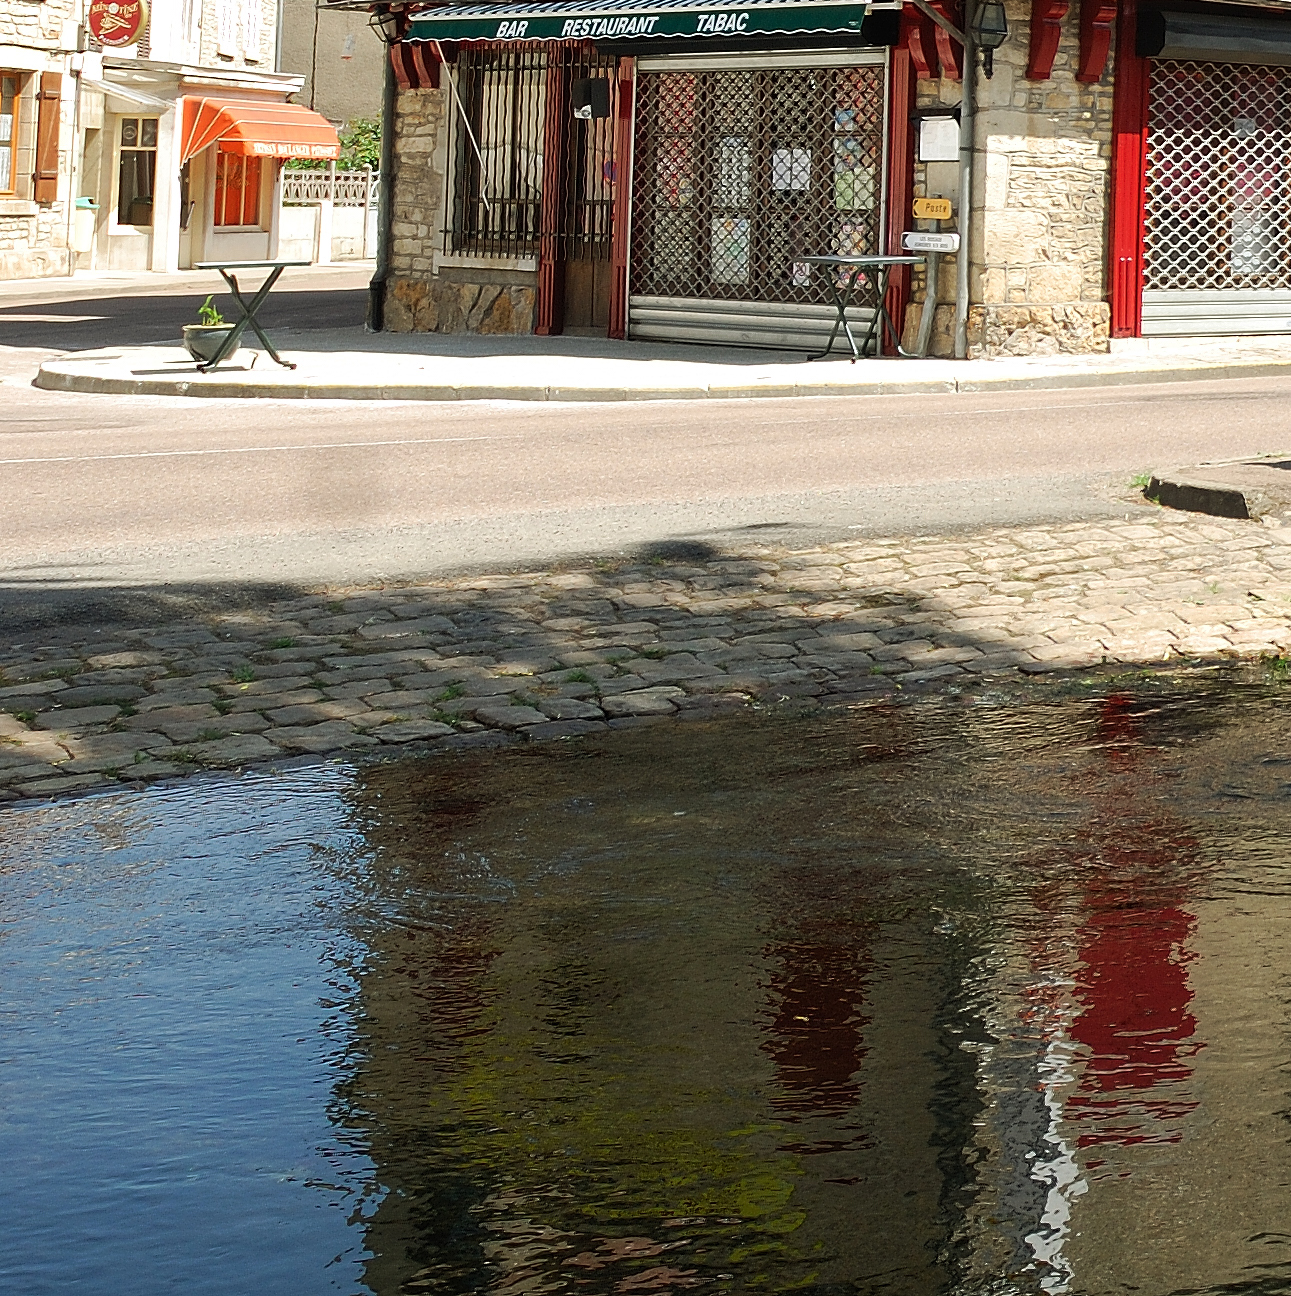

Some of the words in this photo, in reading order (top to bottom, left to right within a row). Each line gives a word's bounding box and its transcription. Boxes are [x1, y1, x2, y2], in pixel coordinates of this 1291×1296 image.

[496, 20, 529, 38] BAR
[561, 16, 660, 37] RESTAURANT
[696, 12, 750, 33] TABAC
[925, 202, 947, 213] Poste
